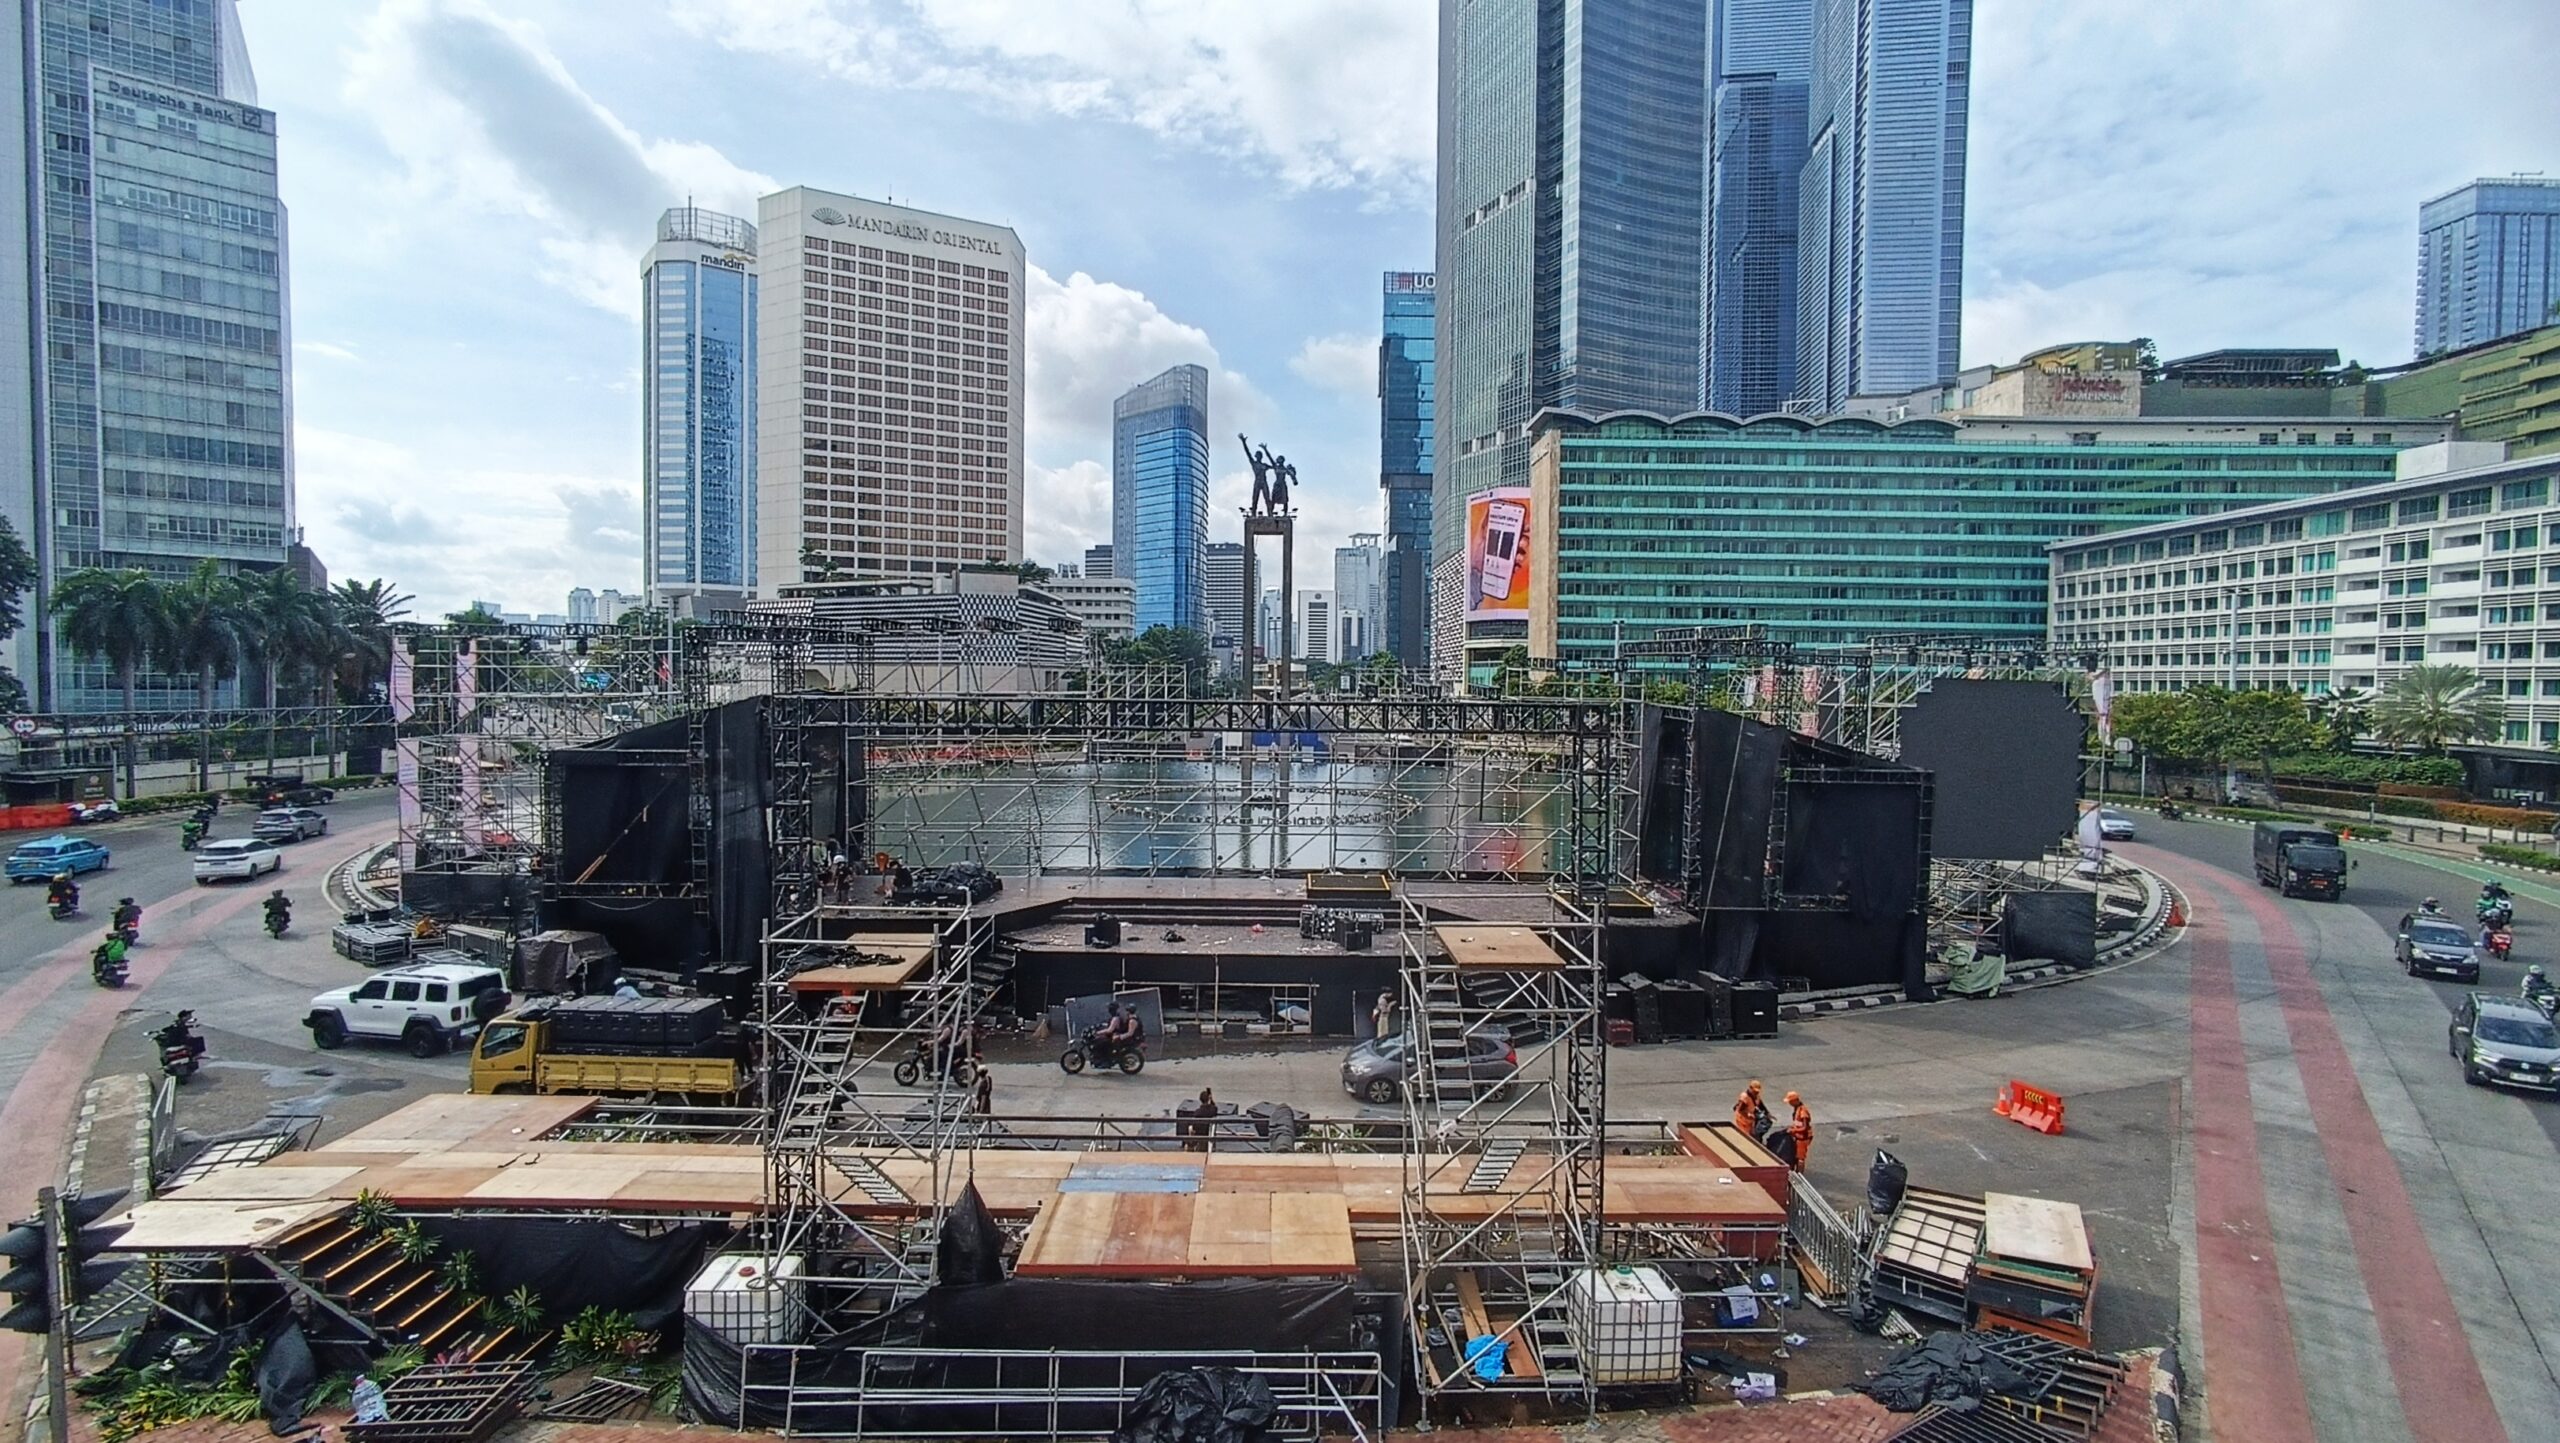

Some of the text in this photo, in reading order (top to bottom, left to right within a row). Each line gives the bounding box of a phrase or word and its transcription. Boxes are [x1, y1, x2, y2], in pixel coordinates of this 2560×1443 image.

[107, 79, 235, 122] Deutsche Bank
[848, 213, 1002, 255] MANDARIN ORIENTAL
[701, 254, 745, 270] mandiri
